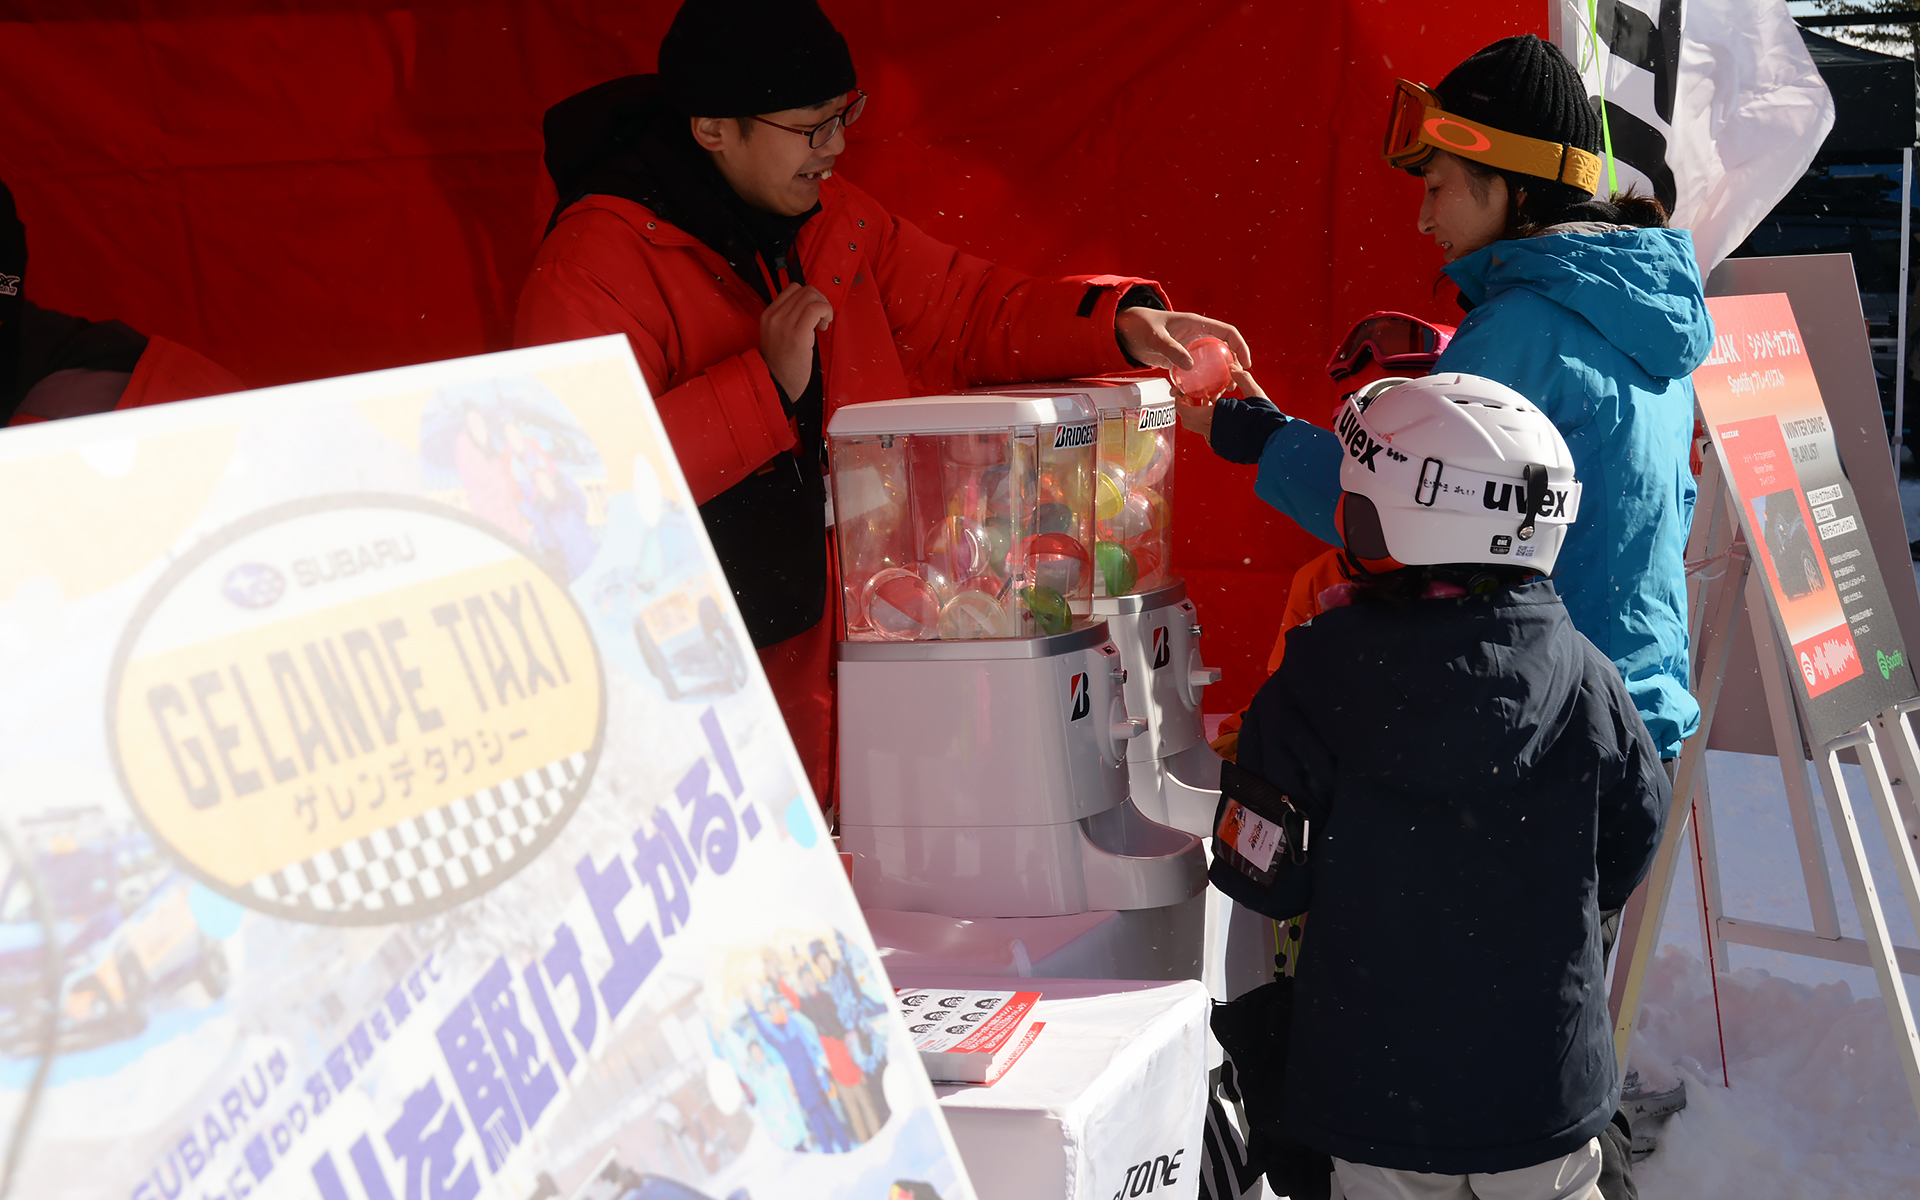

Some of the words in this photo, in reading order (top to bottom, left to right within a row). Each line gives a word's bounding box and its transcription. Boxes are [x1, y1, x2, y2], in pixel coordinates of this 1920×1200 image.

[1339, 405, 1384, 474] uvex
[292, 535, 416, 588] SUBARU
[146, 616, 445, 811] GELANDE
[430, 580, 571, 713] TAXI
[294, 727, 528, 832] ゲレンデタクシー
